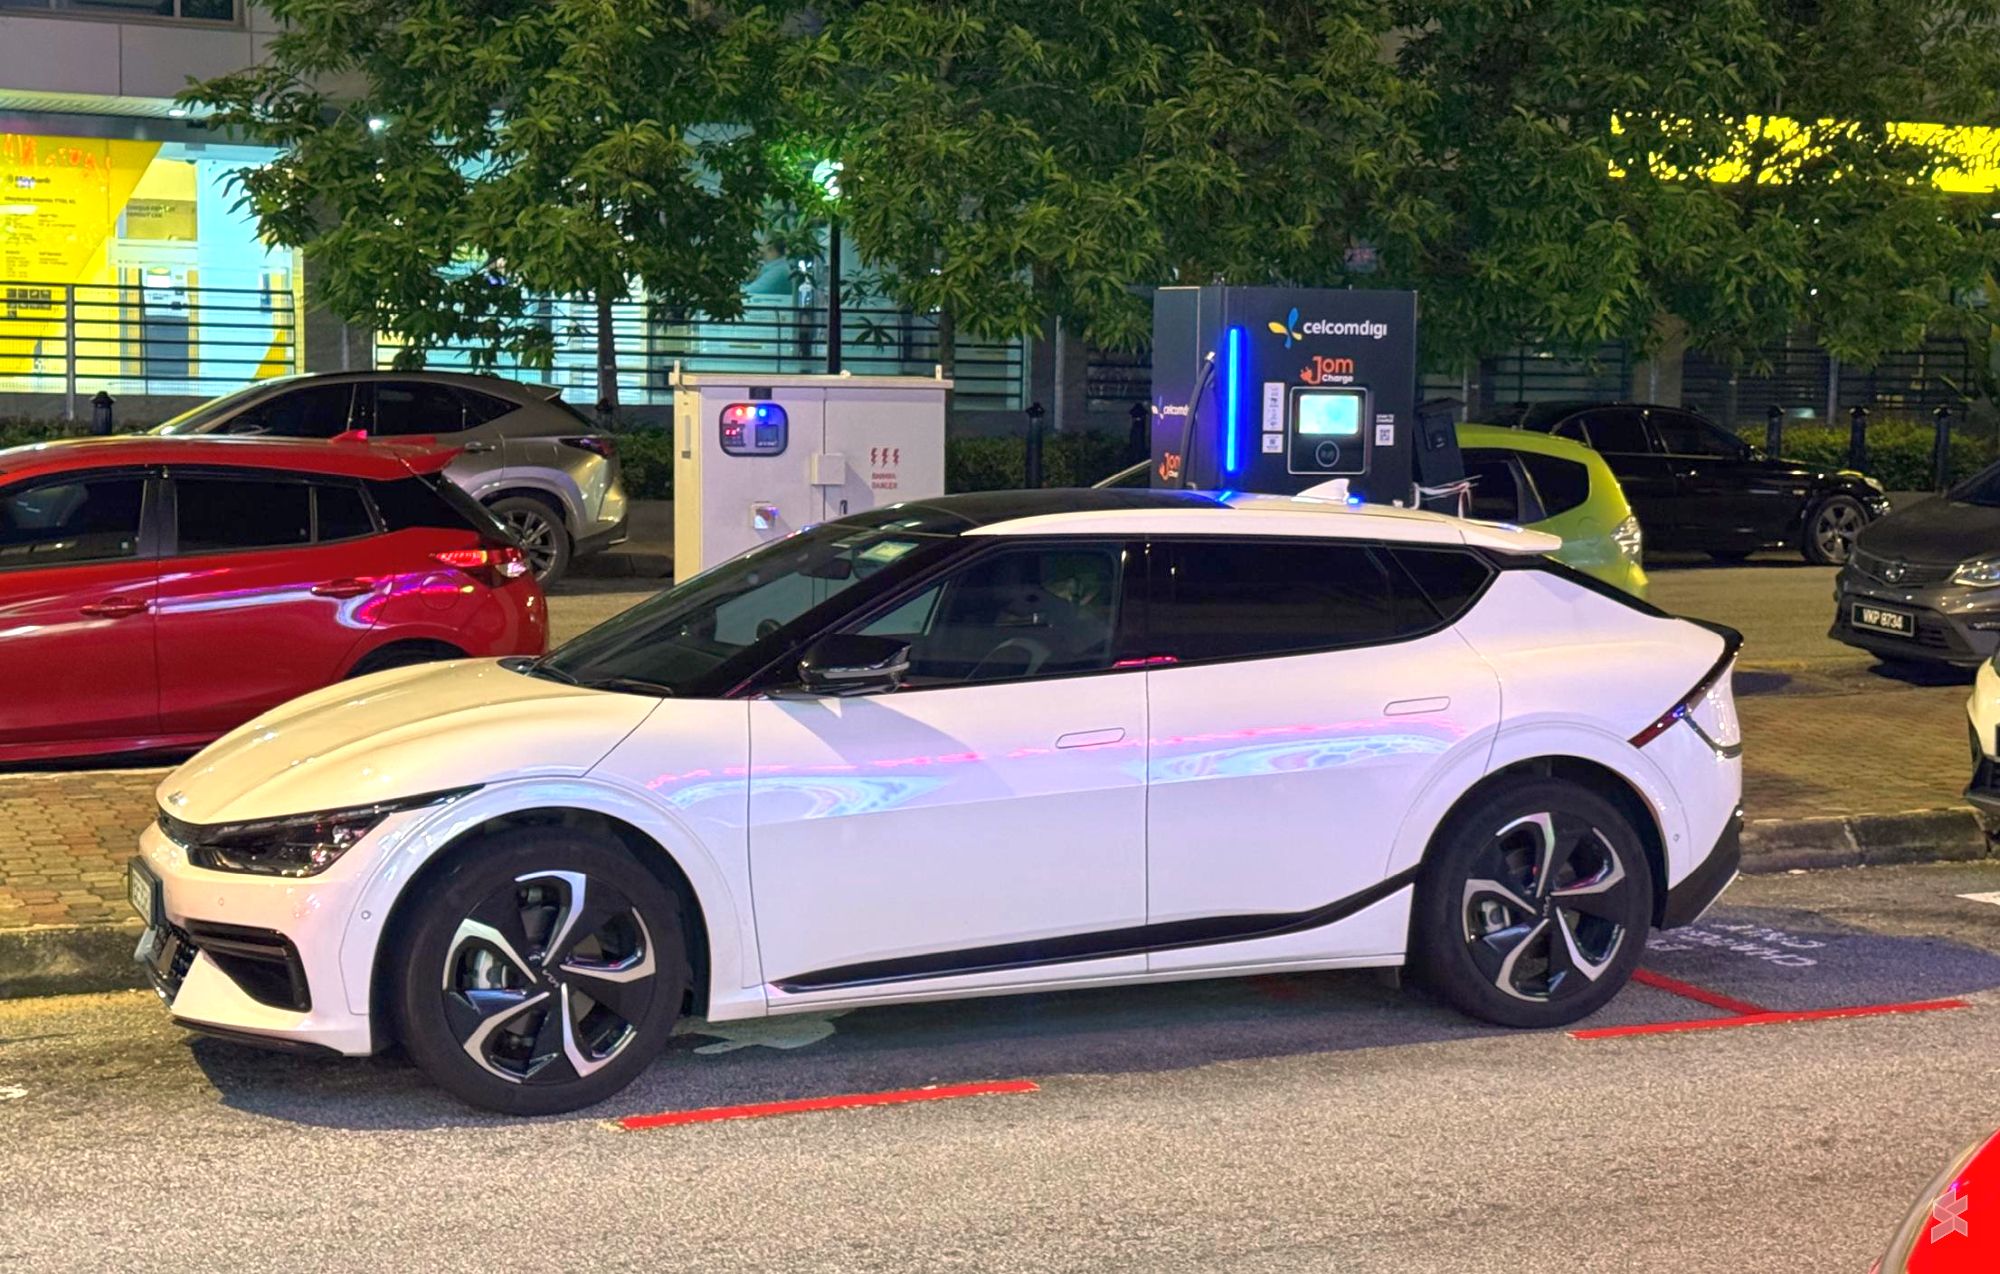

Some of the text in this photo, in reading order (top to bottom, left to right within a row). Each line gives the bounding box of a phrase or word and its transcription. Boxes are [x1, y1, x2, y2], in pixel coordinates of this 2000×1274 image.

[1303, 319, 1388, 340] celcomdigi
[1308, 355, 1354, 385] Jom
[1321, 374, 1354, 385] Charge
[871, 482, 898, 490] DANGER
